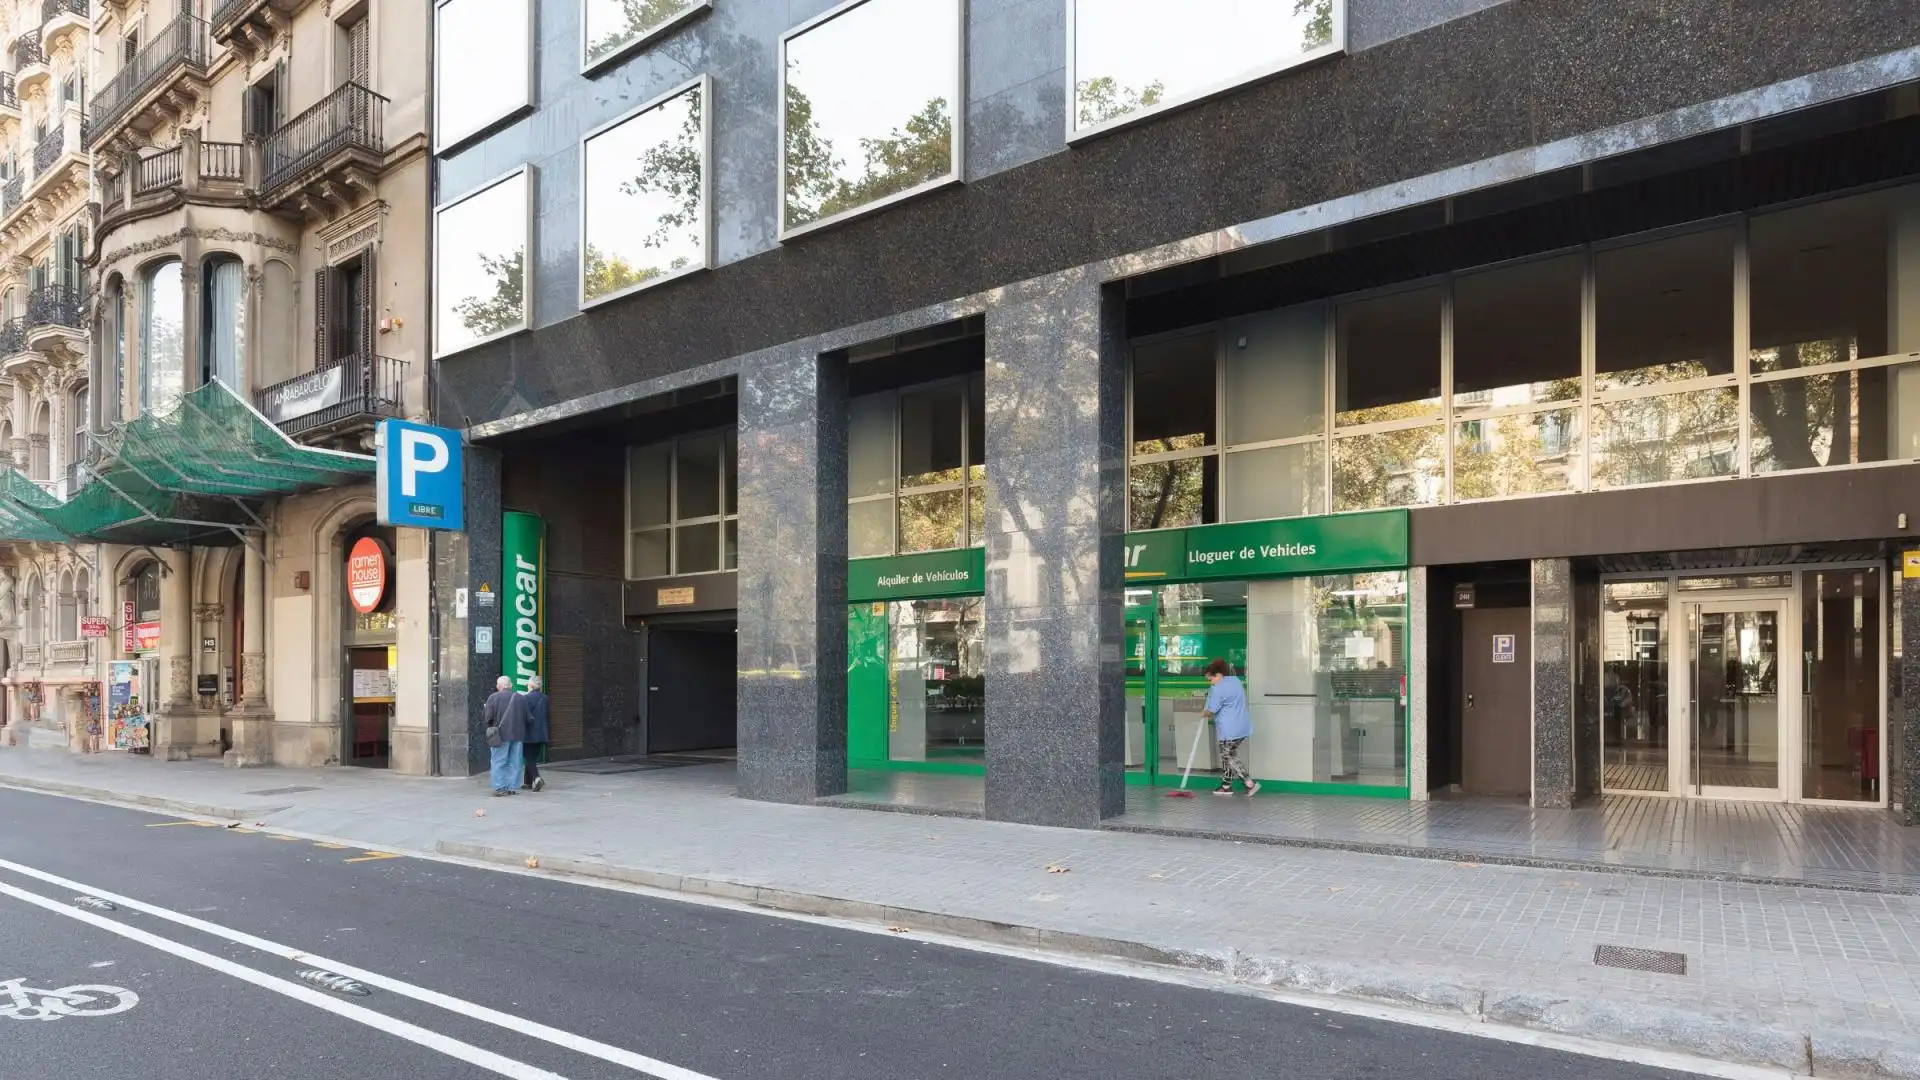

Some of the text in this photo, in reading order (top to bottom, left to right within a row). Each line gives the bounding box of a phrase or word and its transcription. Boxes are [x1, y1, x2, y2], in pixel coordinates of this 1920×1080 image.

[401, 428, 449, 497] P
[413, 504, 437, 515] LIBRE
[351, 554, 381, 569] ramen
[1188, 542, 1316, 565] Lloguer de Vehicles
[351, 567, 381, 581] house
[877, 573, 910, 588] Alquiler
[912, 572, 923, 584] de
[80, 616, 106, 625] SUPER
[516, 554, 543, 696] uropcar
[1497, 637, 1510, 653] P
